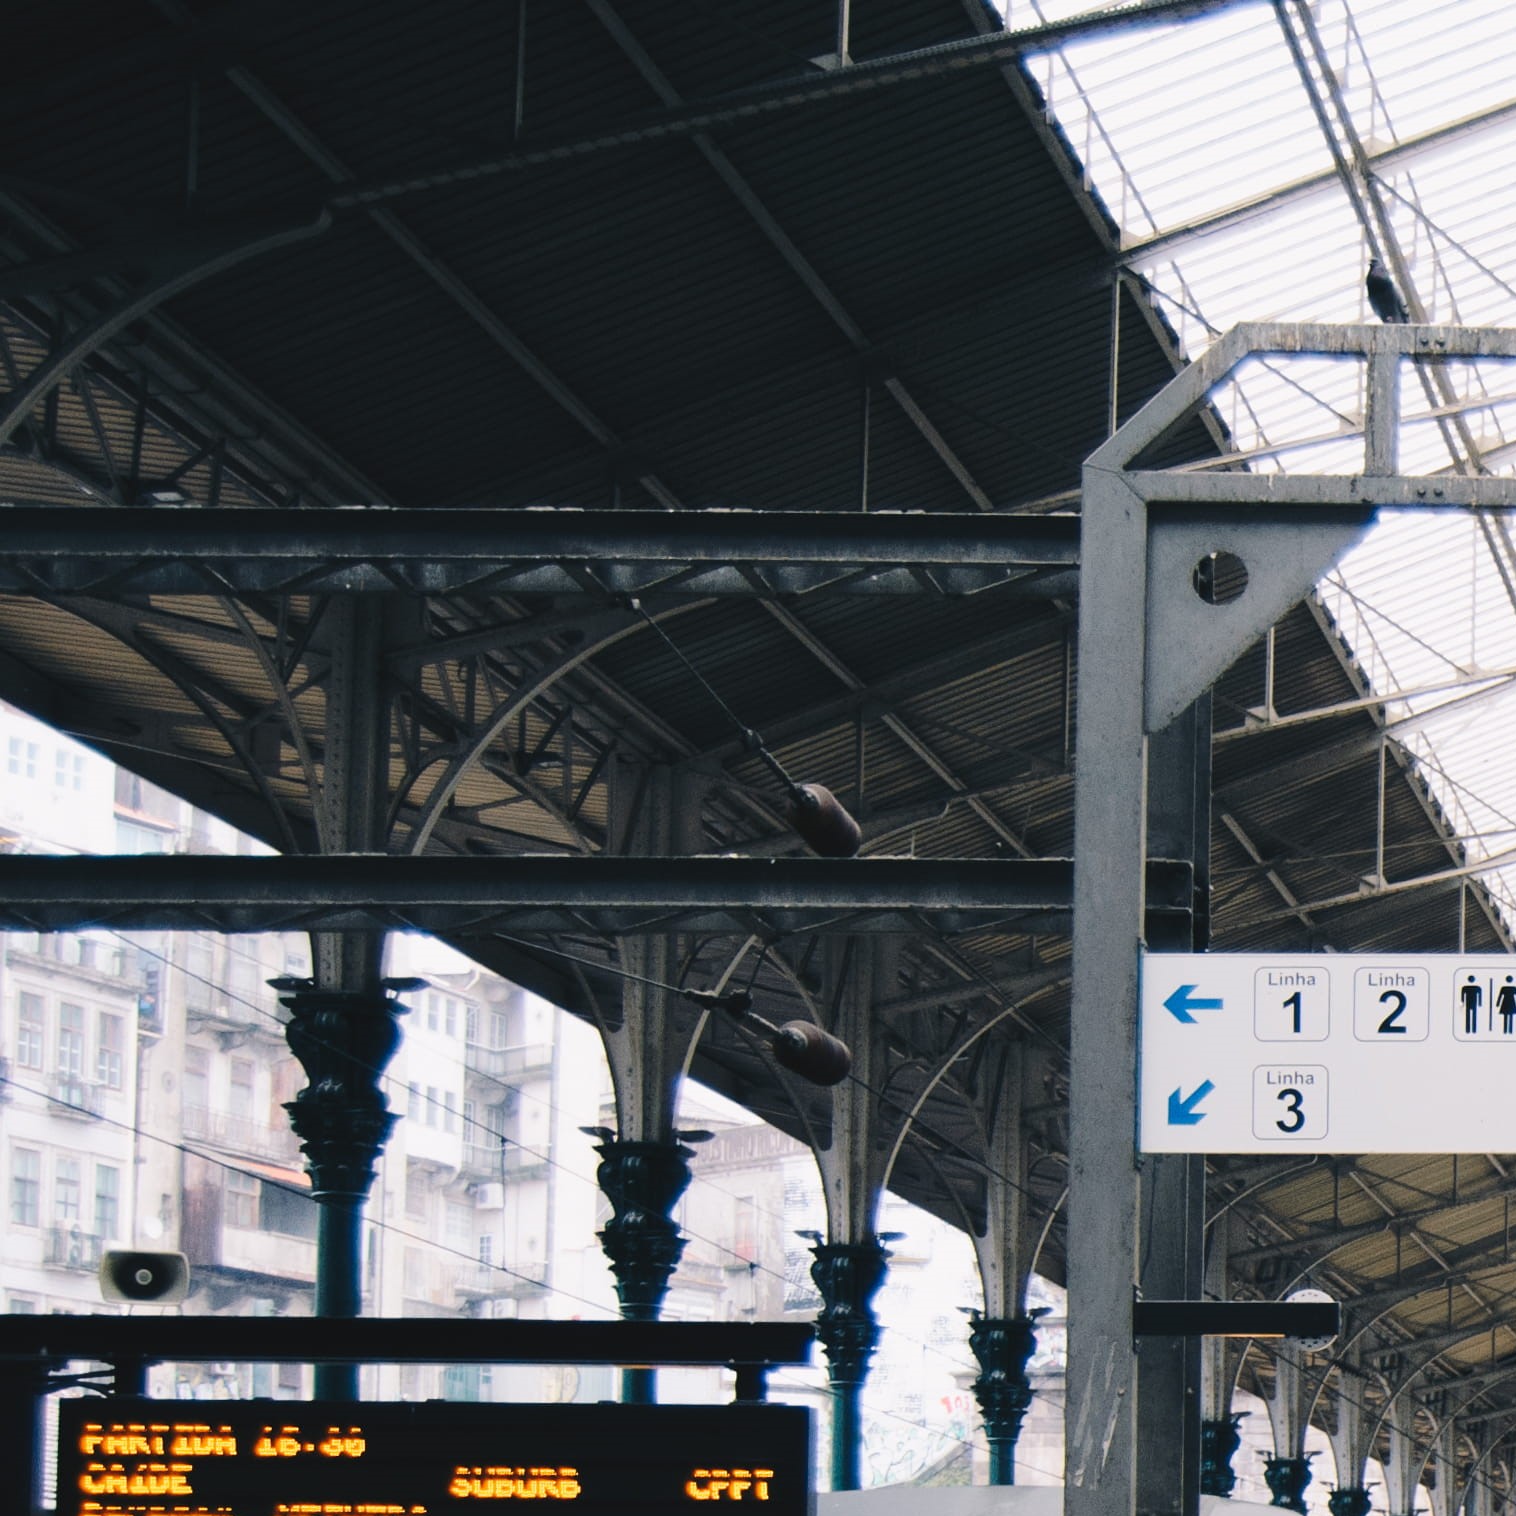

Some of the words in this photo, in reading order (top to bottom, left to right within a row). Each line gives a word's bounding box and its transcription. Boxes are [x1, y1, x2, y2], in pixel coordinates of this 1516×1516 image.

[1267, 972, 1317, 988] Linha
[1368, 972, 1416, 988] Linha
[1282, 991, 1302, 1034] 1
[1377, 990, 1408, 1034] 2
[1266, 1070, 1315, 1086] Linha
[1276, 1088, 1306, 1133] 3
